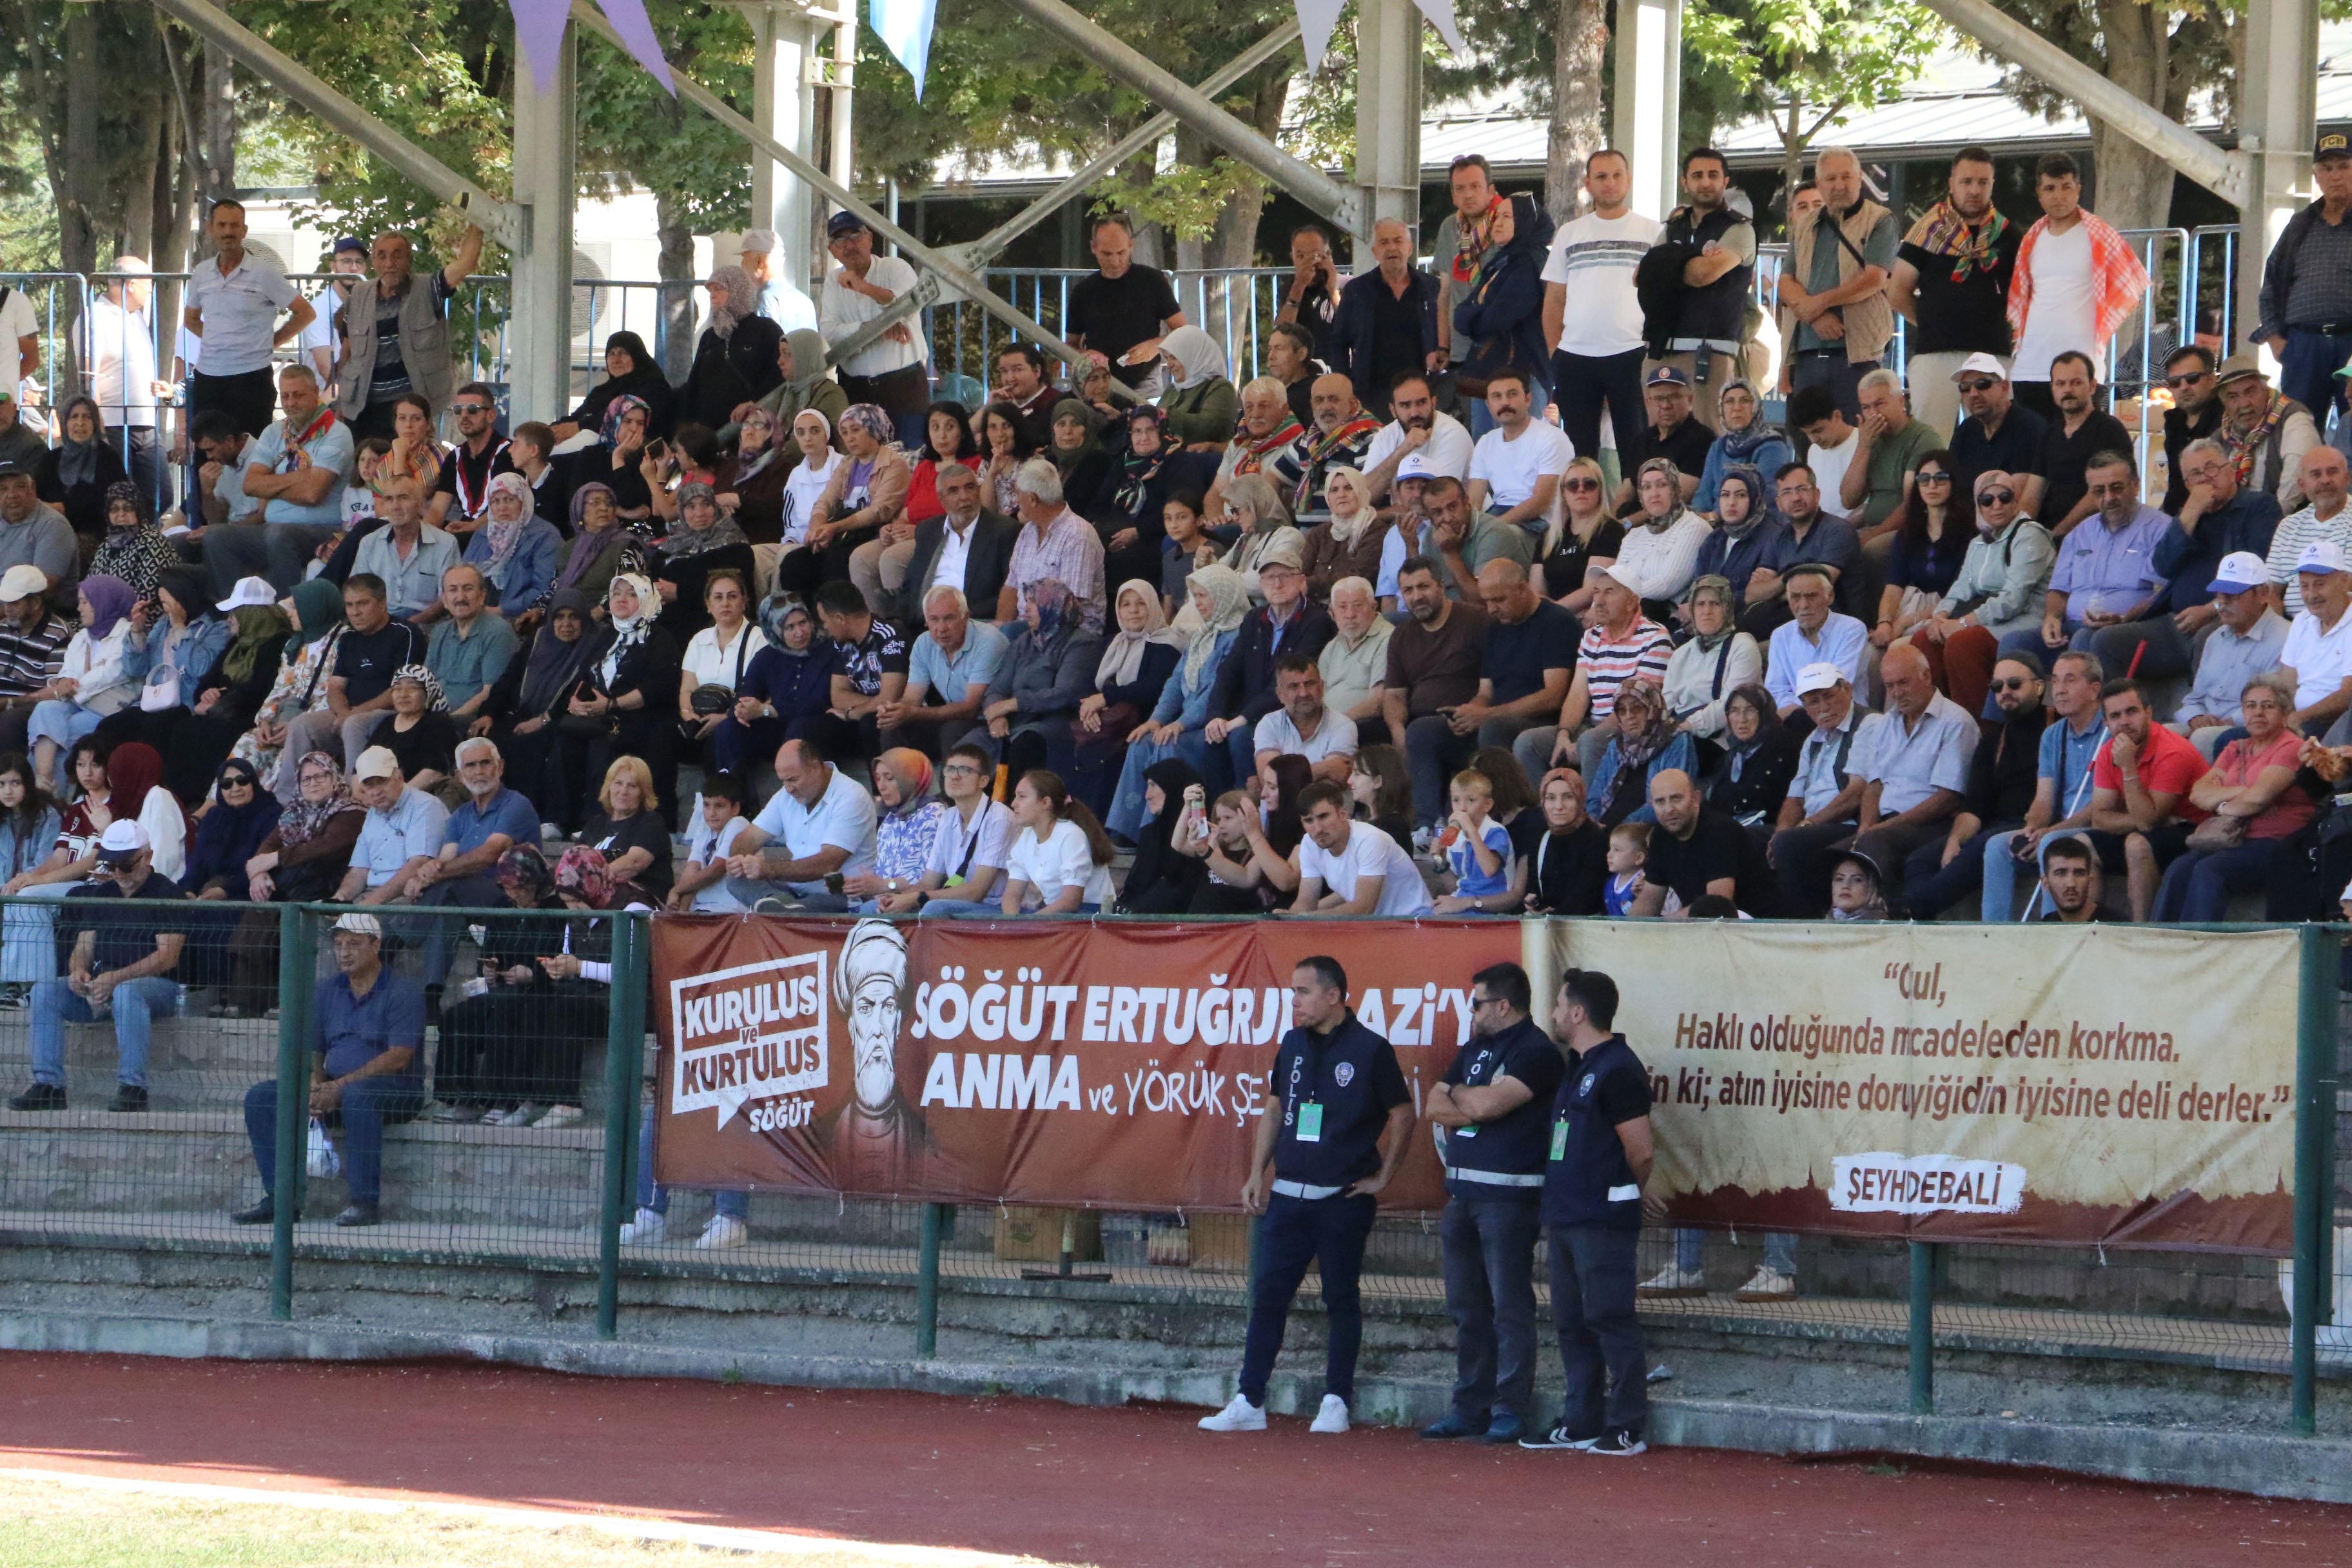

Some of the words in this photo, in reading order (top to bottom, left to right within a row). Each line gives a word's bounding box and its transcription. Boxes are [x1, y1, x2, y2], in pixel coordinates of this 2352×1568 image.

[685, 974, 818, 1039] KURULUŞ
[911, 966, 1077, 1042] SÖĞÜT
[741, 1026, 759, 1044] ve
[1675, 1012, 1745, 1050] Haklı
[1750, 1014, 1884, 1059] olduğunda
[2068, 1021, 2180, 1063] korkma.
[681, 1035, 820, 1096] KURTULUŞ
[920, 1052, 1081, 1111] ANMA
[1088, 1084, 1117, 1115] ve
[1124, 1059, 1225, 1116] YÖRÜK
[749, 1100, 814, 1133] SÖĞÜT
[1676, 1066, 1712, 1112] ki;
[1719, 1071, 1765, 1106] atın
[1772, 1070, 1851, 1114] iyisine
[2015, 1076, 2109, 1122] iyisine
[2118, 1081, 2171, 1120] deli
[2179, 1083, 2290, 1123] derler.”
[1848, 1165, 2003, 1206] ŞEYHDEBALİ
